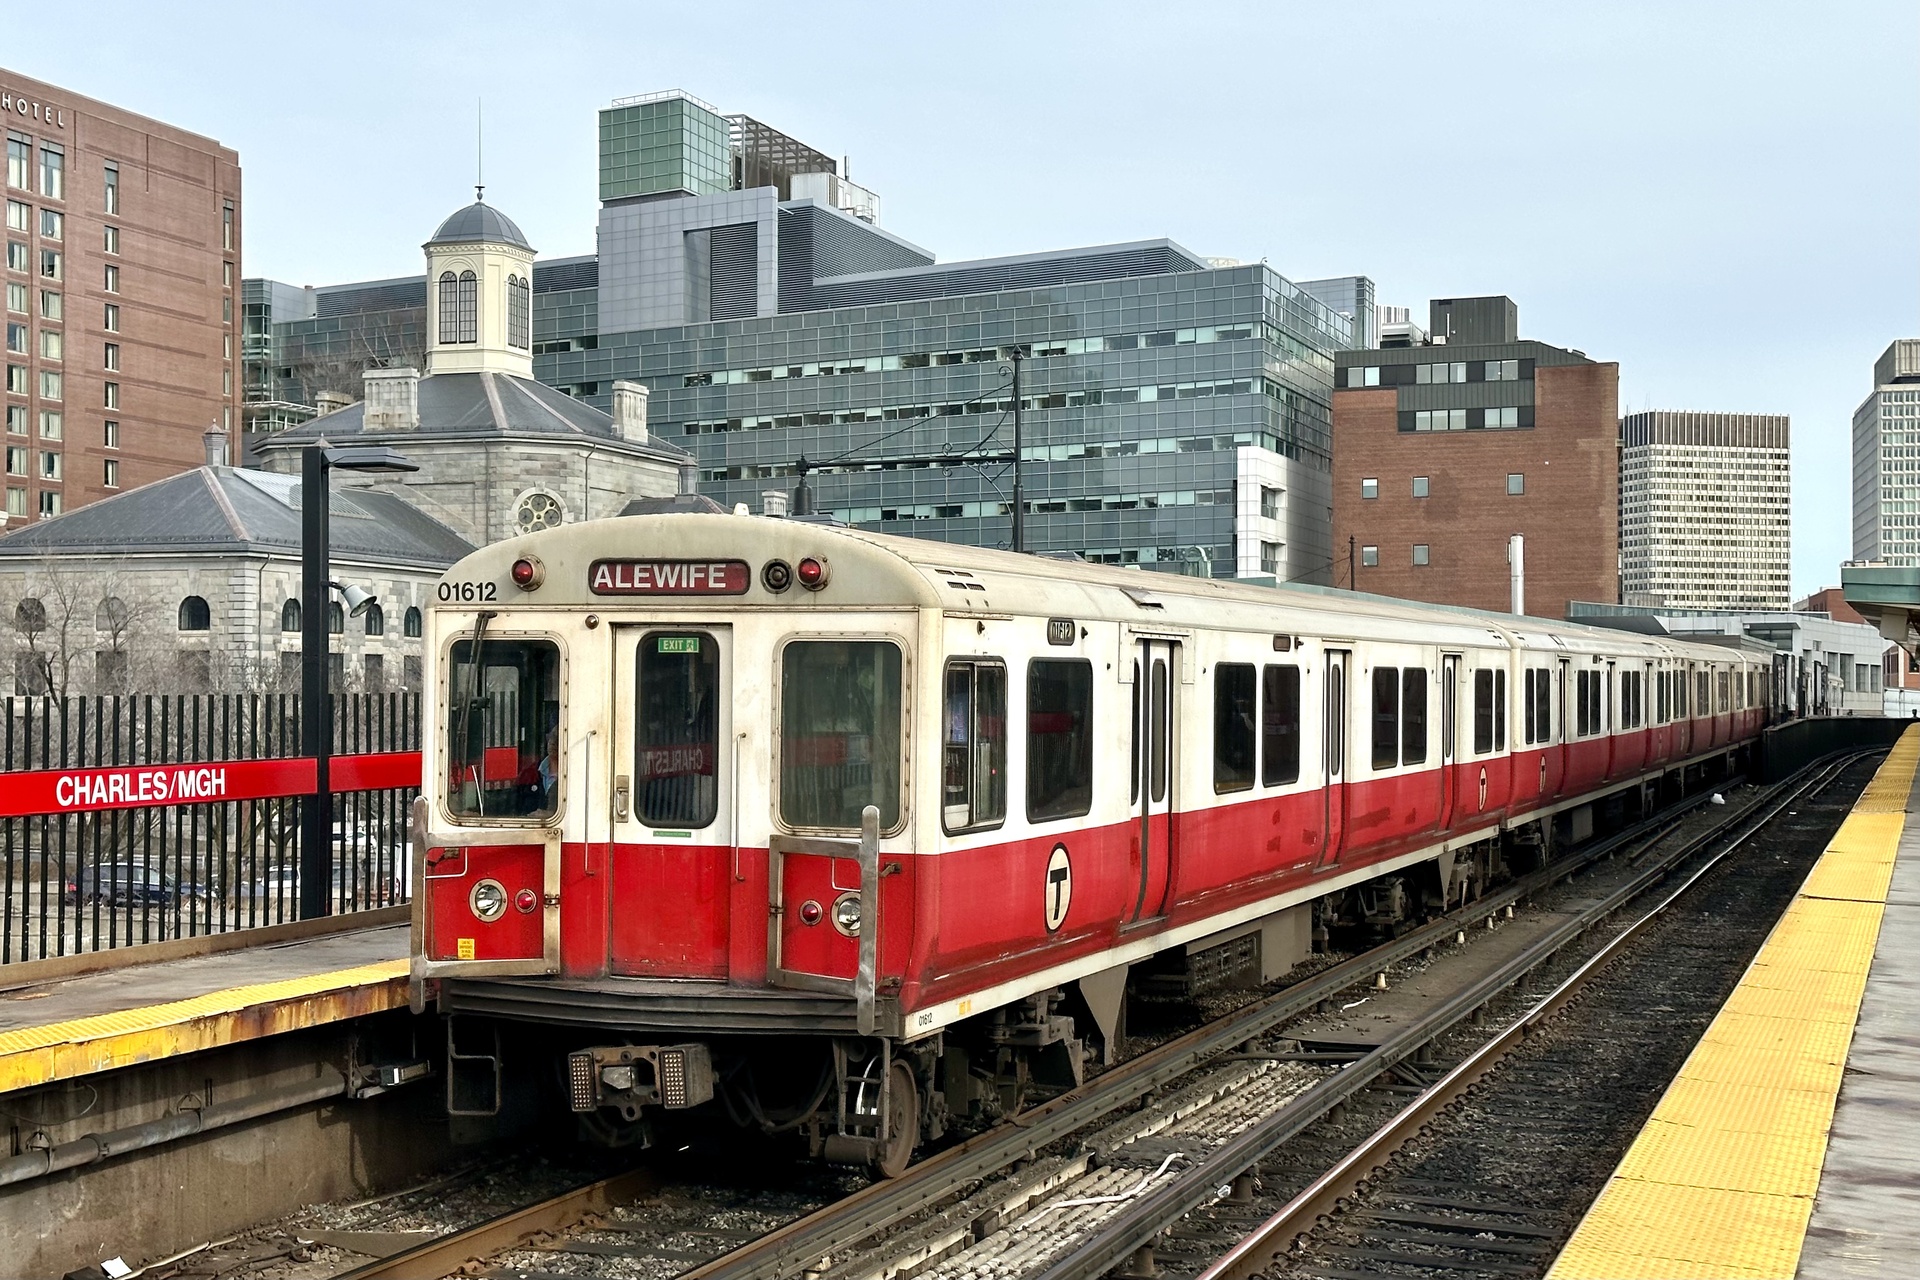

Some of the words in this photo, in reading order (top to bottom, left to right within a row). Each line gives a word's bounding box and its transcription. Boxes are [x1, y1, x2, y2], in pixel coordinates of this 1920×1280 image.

[2, 92, 65, 126] HOTEL
[593, 563, 727, 588] ALEWIFE
[437, 581, 497, 602] 01612
[663, 639, 684, 650] EXIT
[56, 768, 226, 807] CHARLES/MGH
[1050, 867, 1067, 920] T
[918, 1012, 933, 1026] 01612
